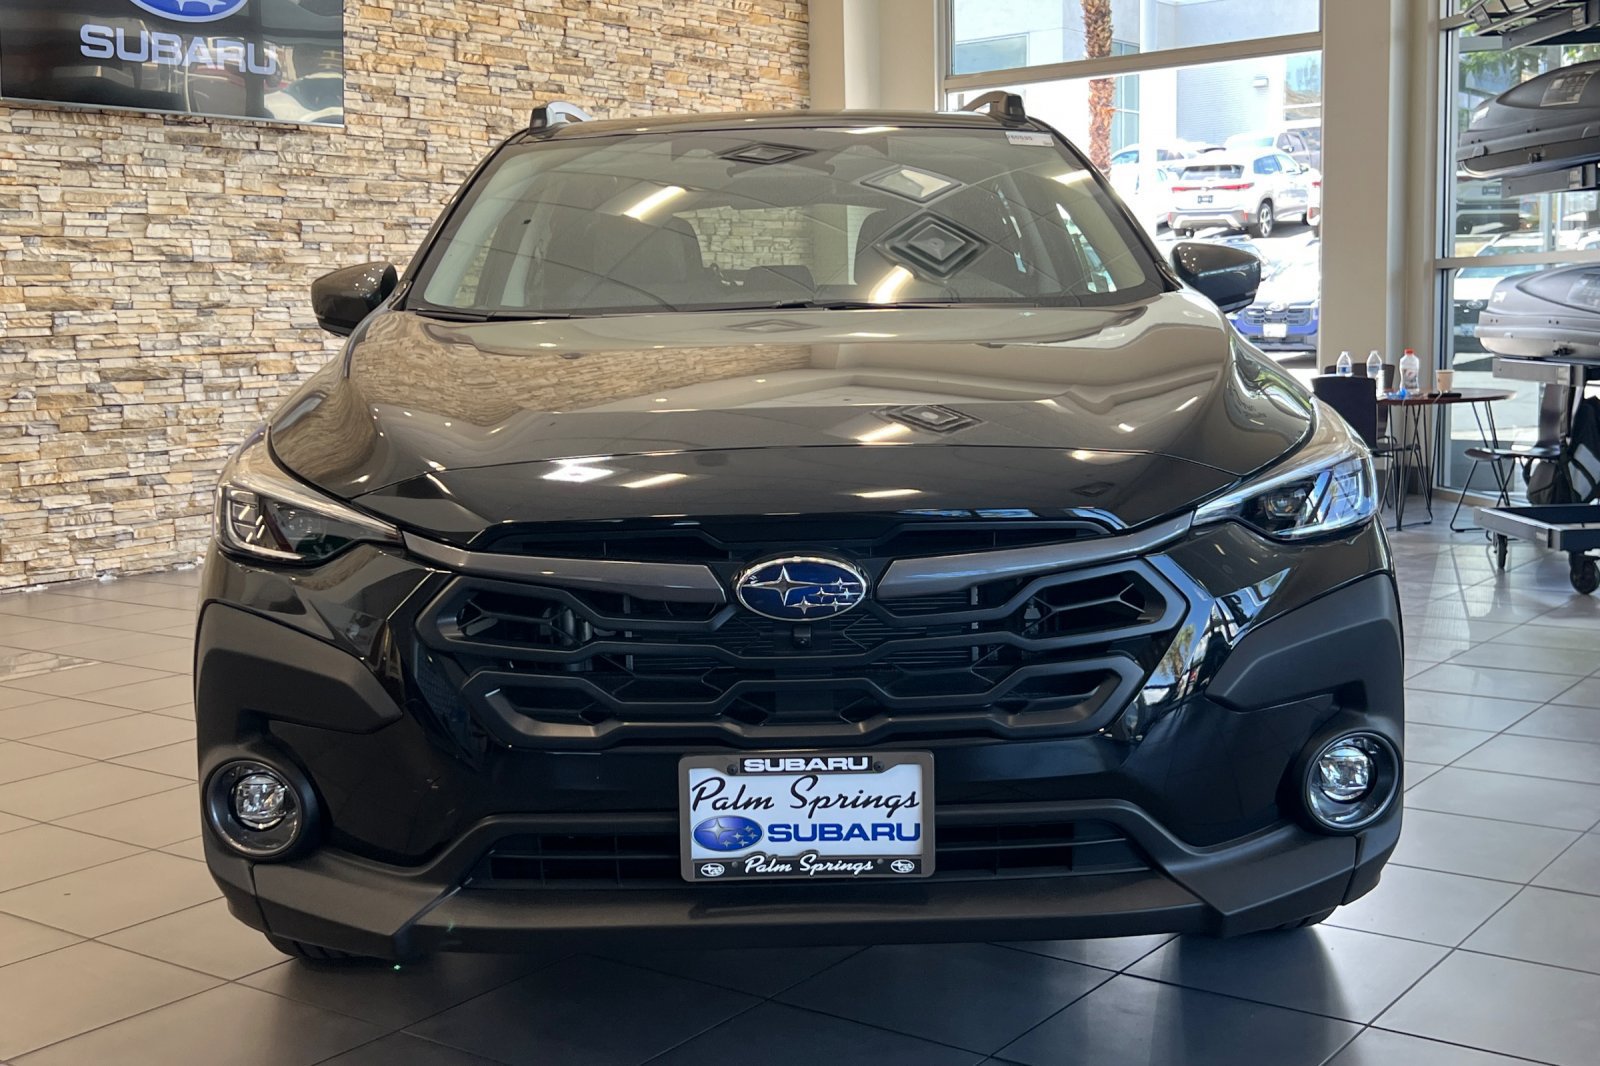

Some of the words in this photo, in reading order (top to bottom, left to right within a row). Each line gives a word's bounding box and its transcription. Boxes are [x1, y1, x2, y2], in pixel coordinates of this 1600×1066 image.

[80, 24, 278, 75] SUBARU
[743, 757, 868, 772] SUBARU
[692, 777, 774, 811] Palm
[789, 775, 920, 819] Springs
[768, 823, 921, 841] SUBARU
[744, 854, 793, 874] Palm
[799, 854, 873, 876] Springs
